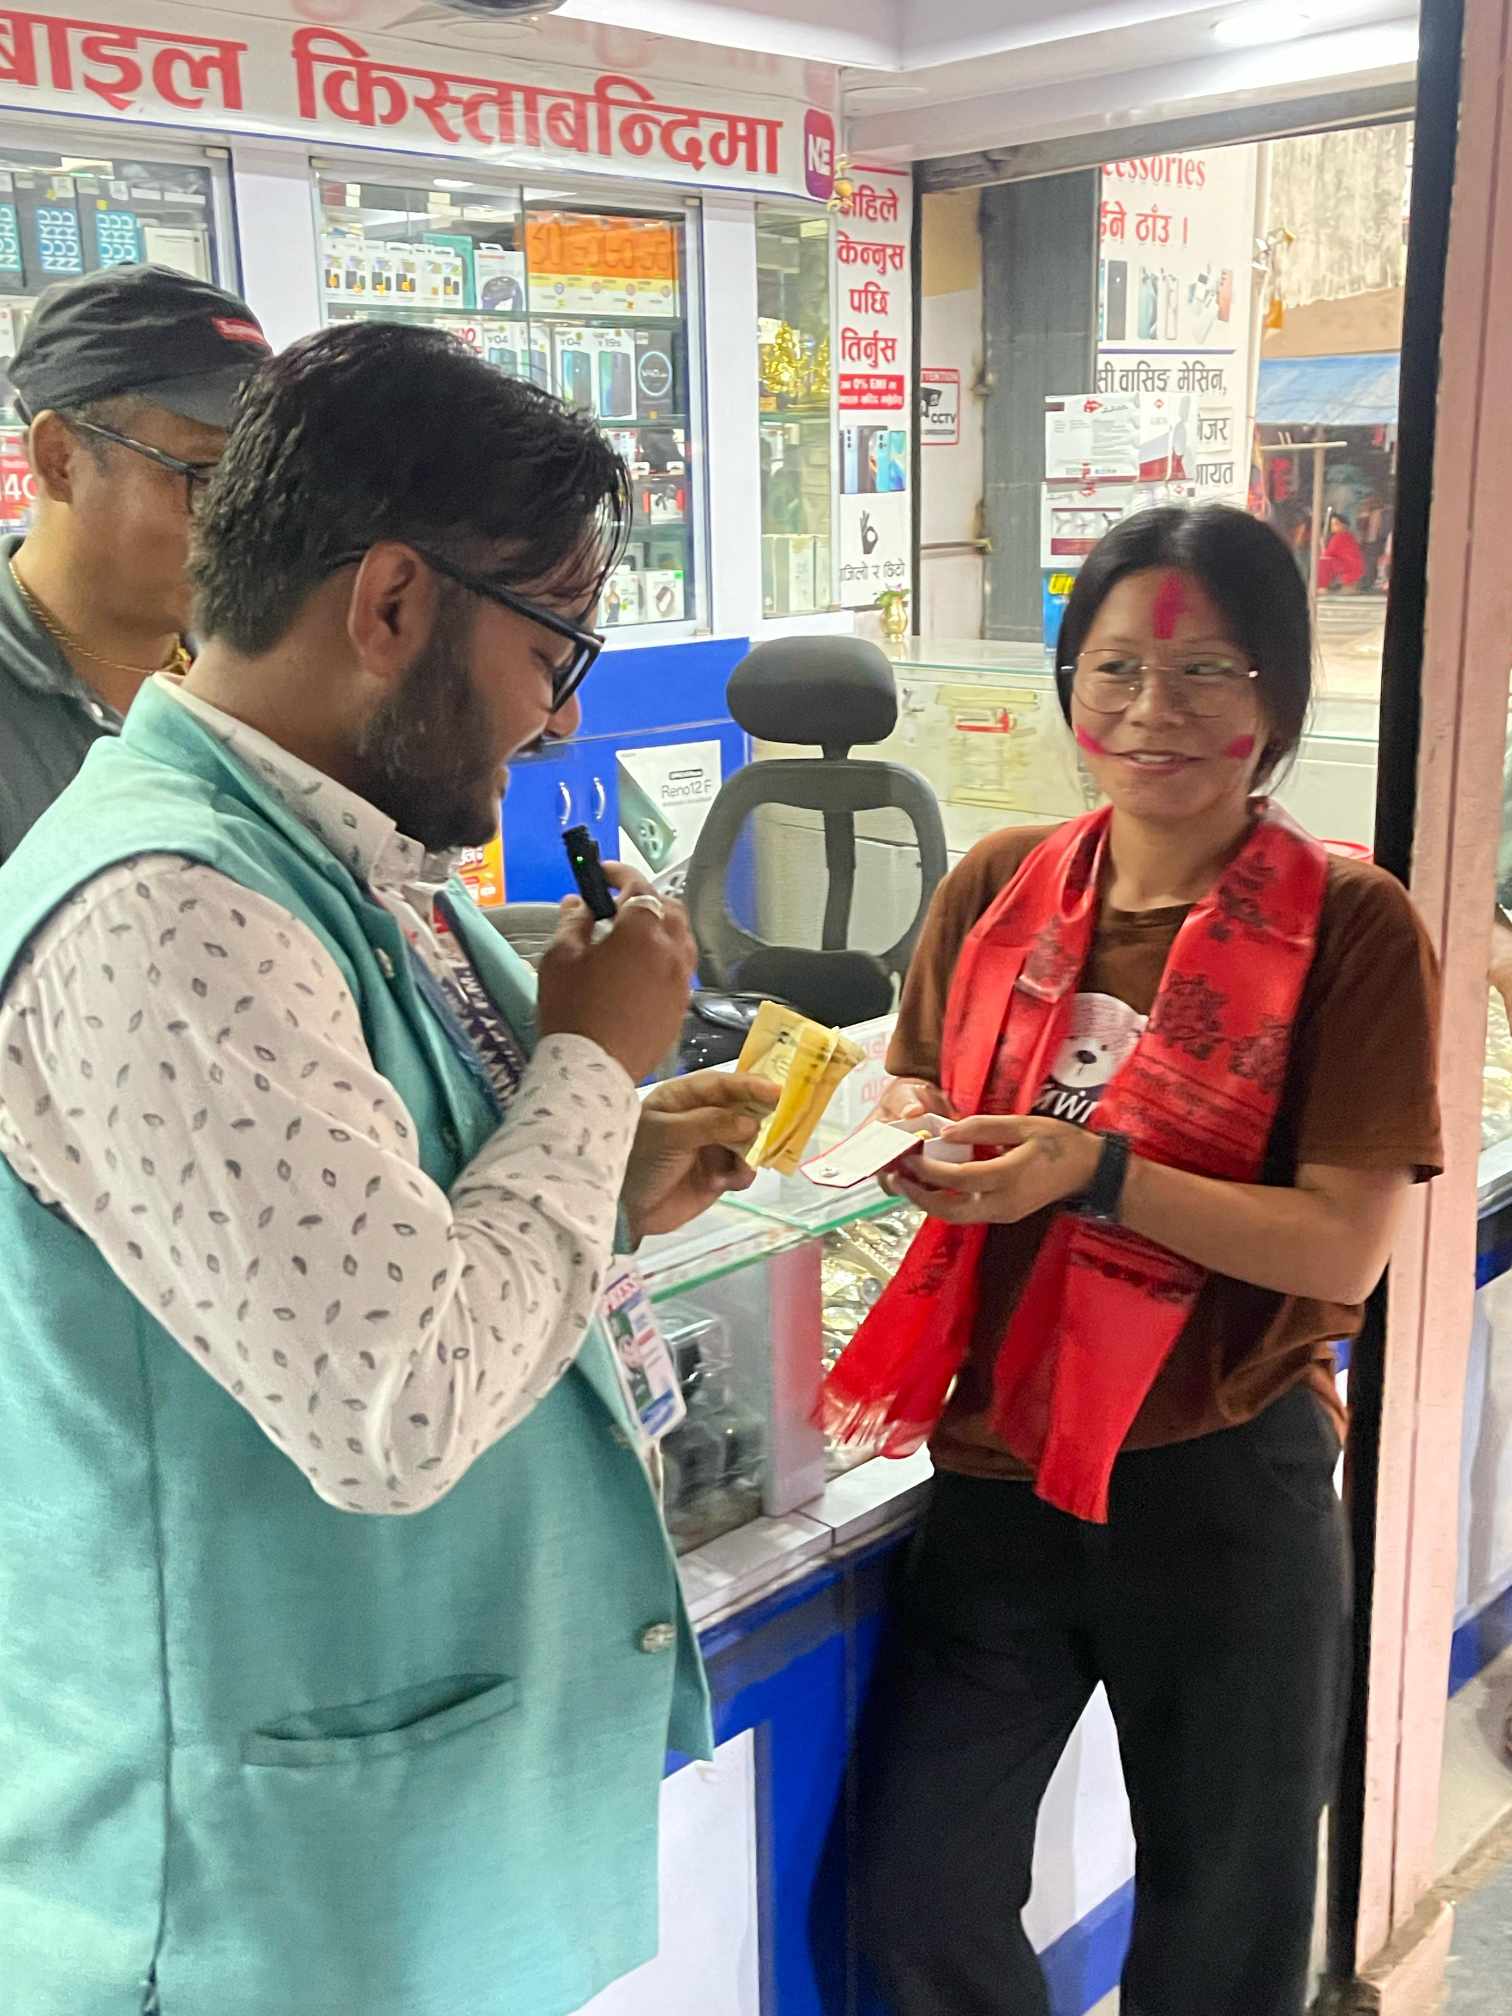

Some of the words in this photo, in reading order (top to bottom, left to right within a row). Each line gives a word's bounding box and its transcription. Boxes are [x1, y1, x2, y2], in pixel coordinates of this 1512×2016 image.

[291, 26, 785, 175] किस्ताबन्दिमा
[849, 281, 889, 316] पछि
[841, 326, 897, 369] तिर्नुस
